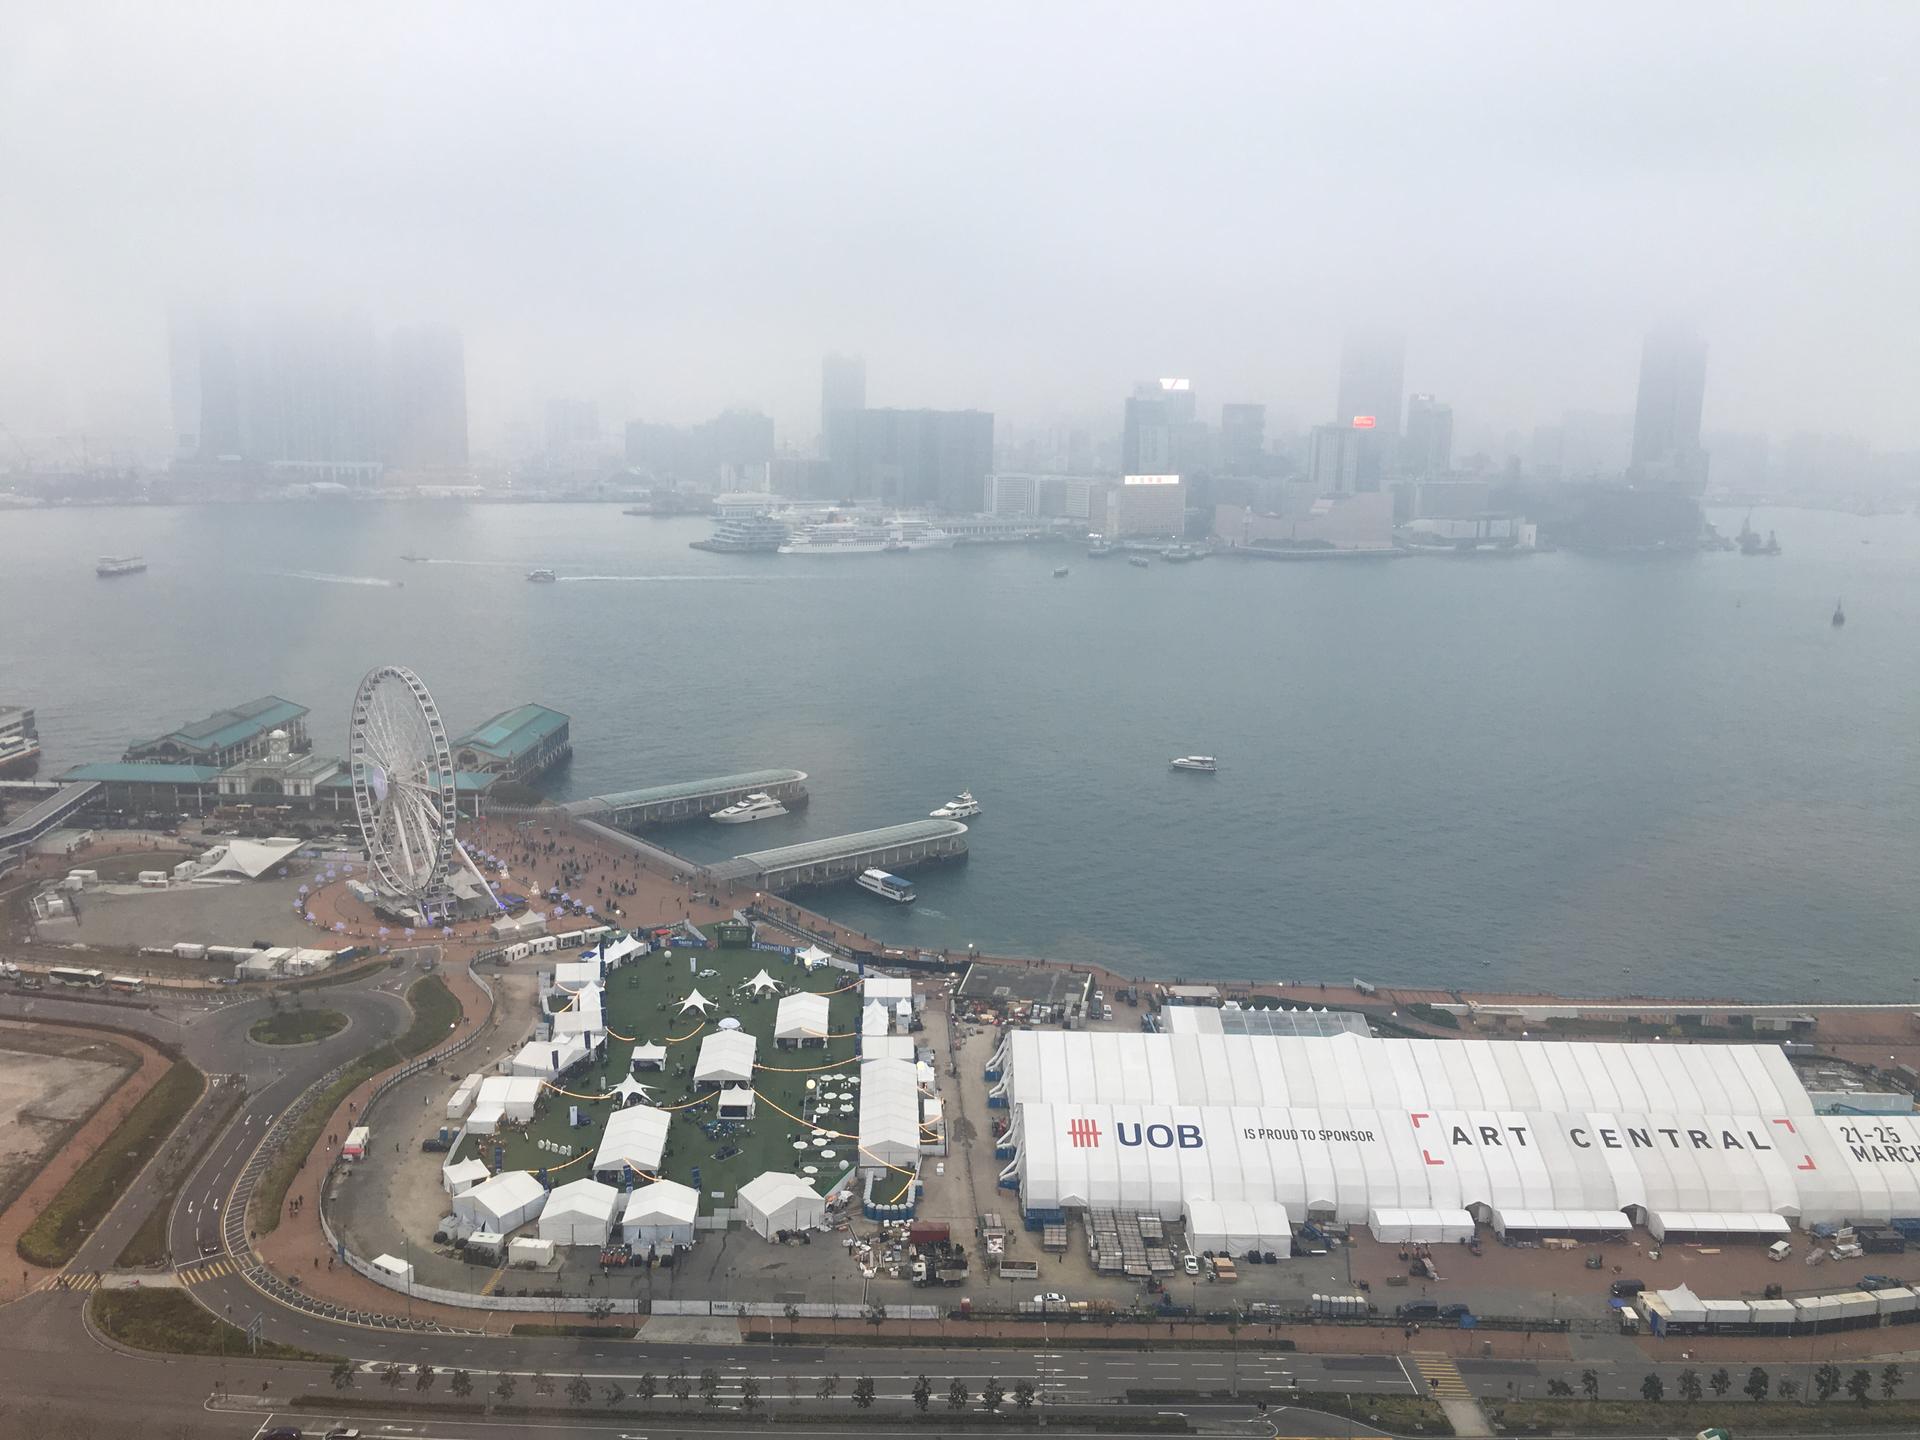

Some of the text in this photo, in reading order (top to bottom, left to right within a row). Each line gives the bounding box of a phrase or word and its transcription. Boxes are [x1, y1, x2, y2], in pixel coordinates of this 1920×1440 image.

[1117, 1122, 1772, 1150] UOB IS PROUD TO SPONSOR ART CENTRAL
[1840, 1126, 1902, 1144] 21-25
